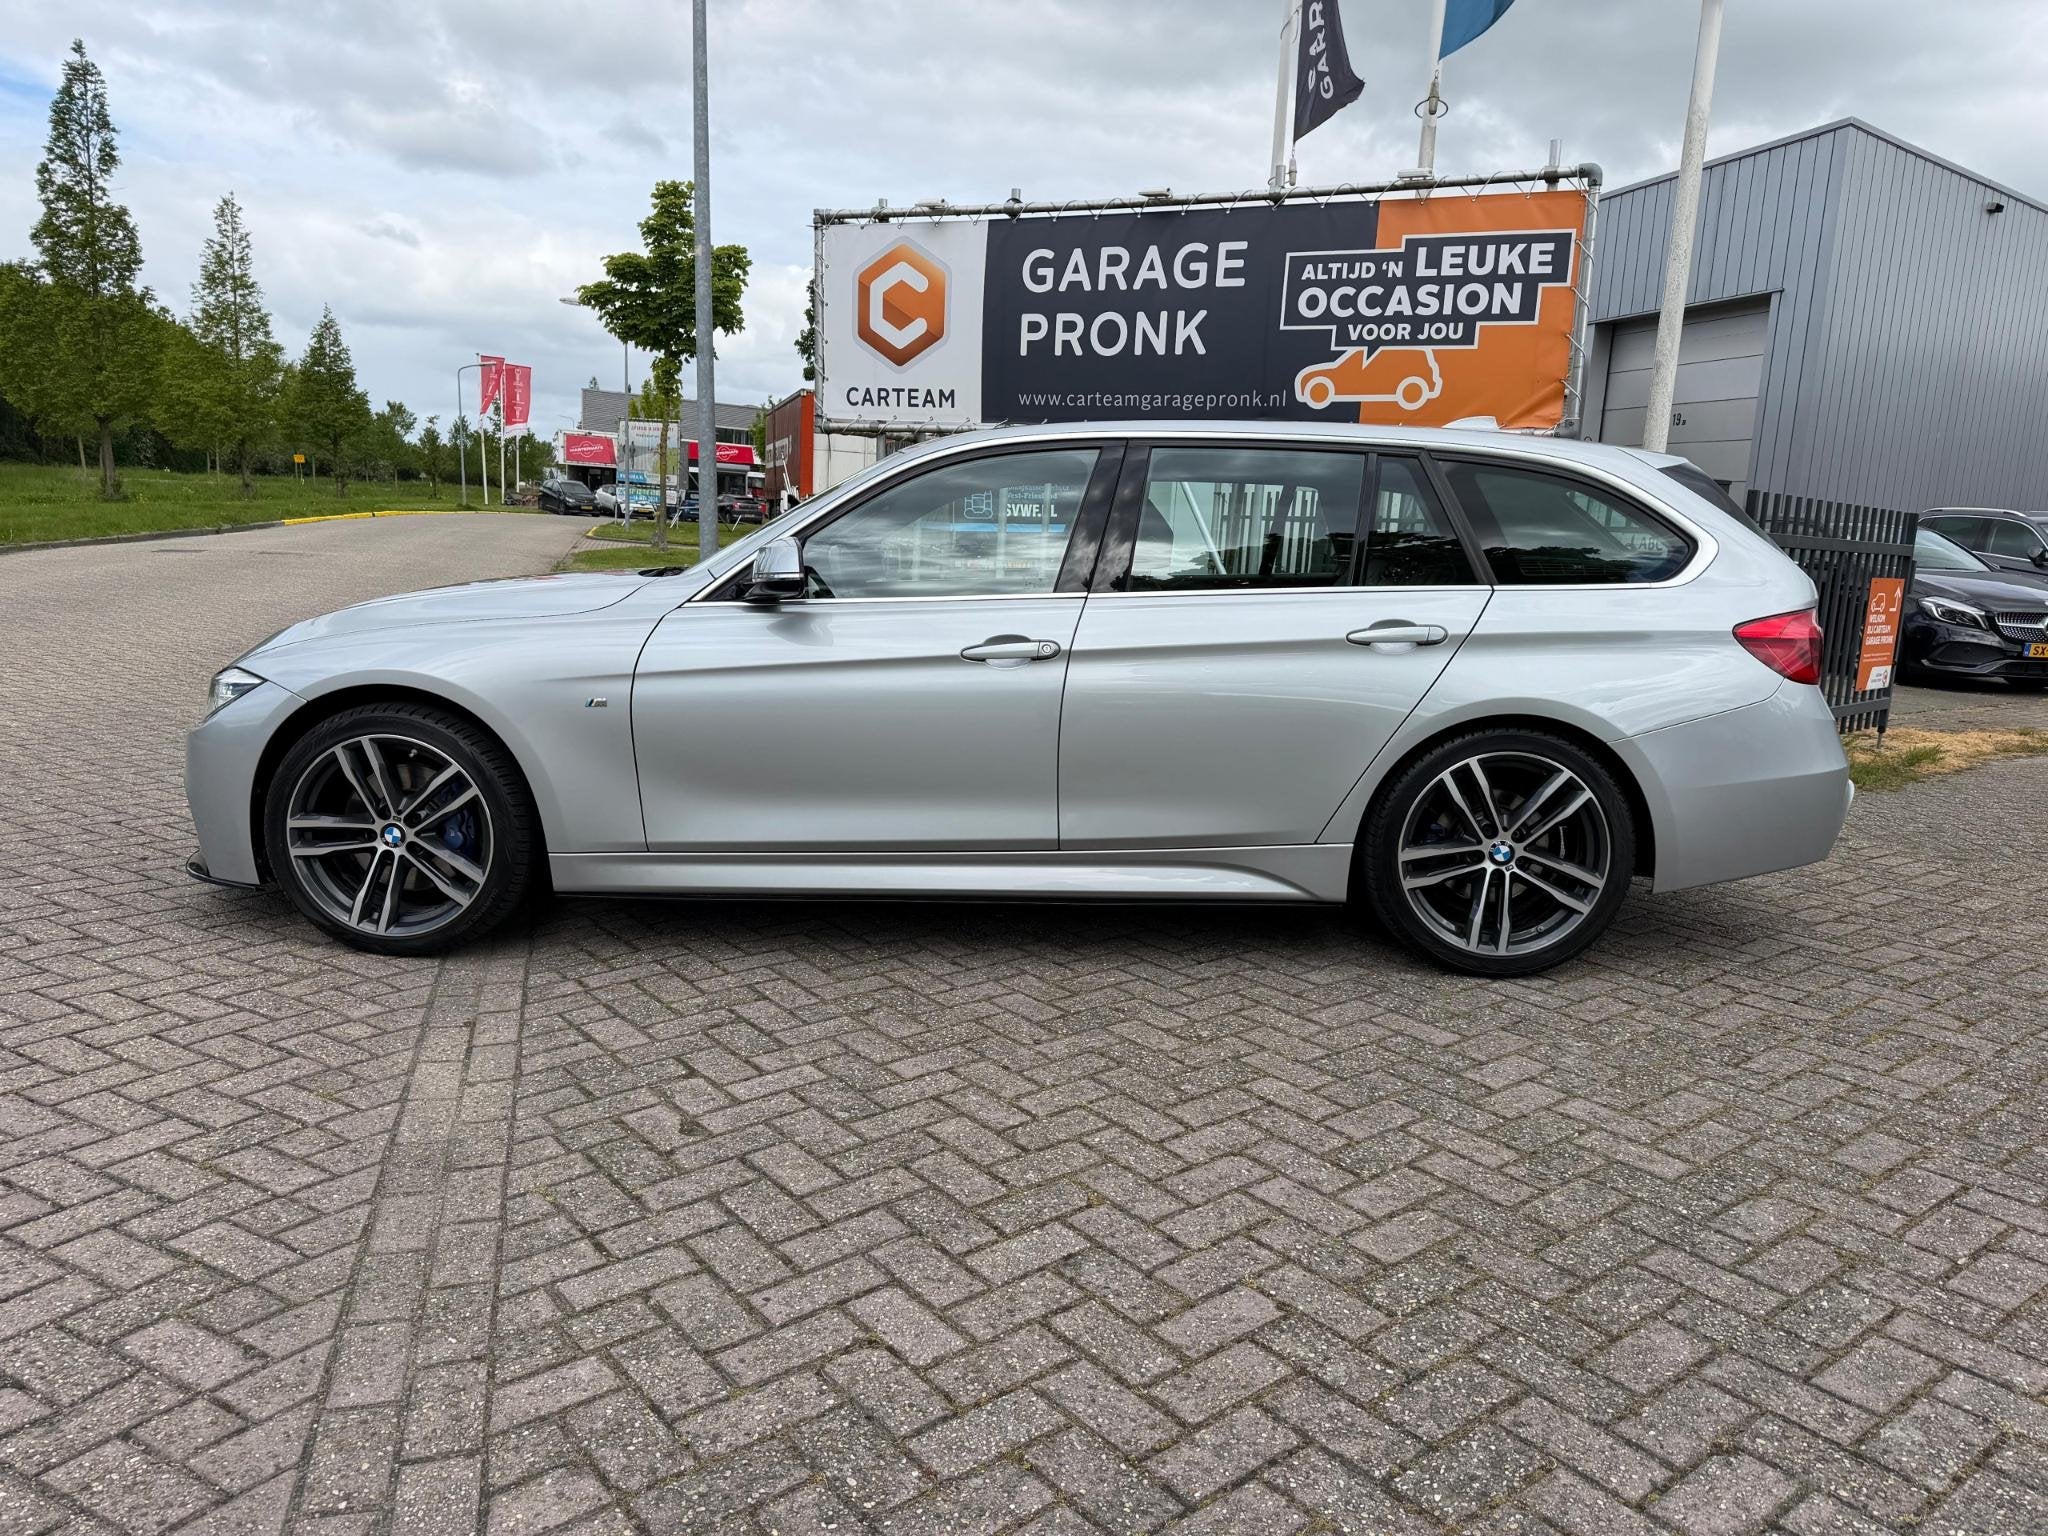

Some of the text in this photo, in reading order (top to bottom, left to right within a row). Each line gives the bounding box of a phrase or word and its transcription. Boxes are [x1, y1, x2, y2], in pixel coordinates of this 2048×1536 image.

[1022, 240, 1249, 293] GARAGE
[1301, 261, 1376, 281] ALTIJD
[1415, 242, 1555, 278] LEUKE
[1297, 282, 1523, 319] OCCASION
[1020, 309, 1208, 357] PRONK
[1348, 322, 1464, 341] VOOR JOU
[846, 386, 956, 409] CARTEAM
[1018, 389, 1287, 411] www.carteamgaragepronk.nl
